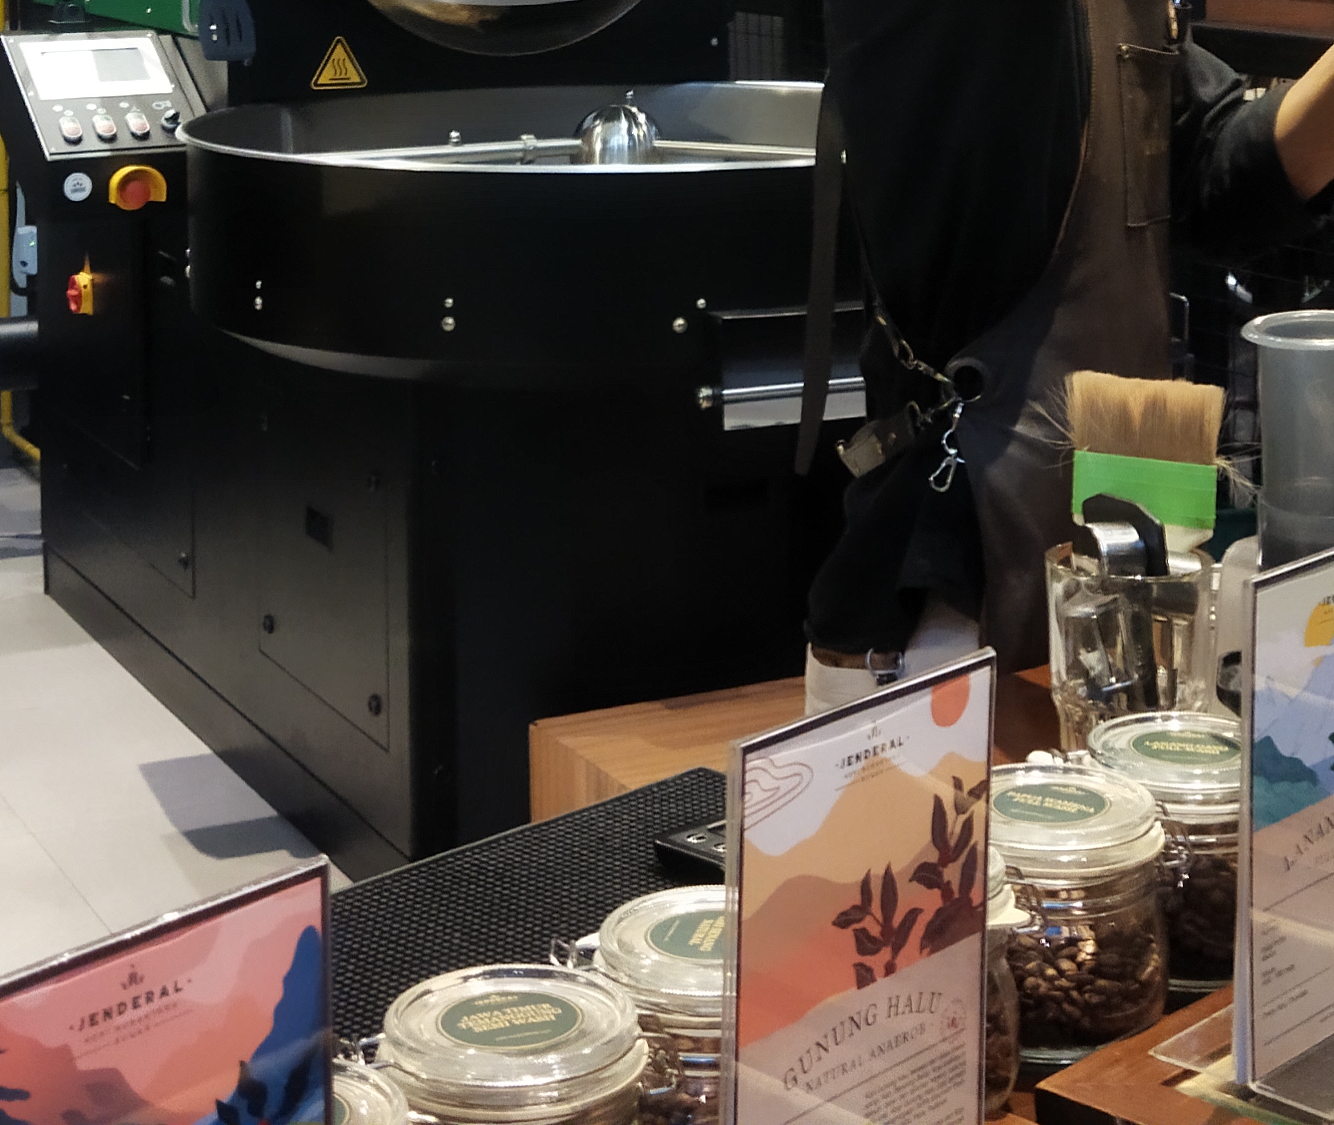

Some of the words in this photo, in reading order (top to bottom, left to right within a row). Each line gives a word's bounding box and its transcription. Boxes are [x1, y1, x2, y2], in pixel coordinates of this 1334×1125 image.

[840, 736, 904, 769] JENDERAL
[78, 980, 184, 1032] JENDERAL
[783, 1003, 878, 1091] GUNUNG
[886, 991, 943, 1020] HALU
